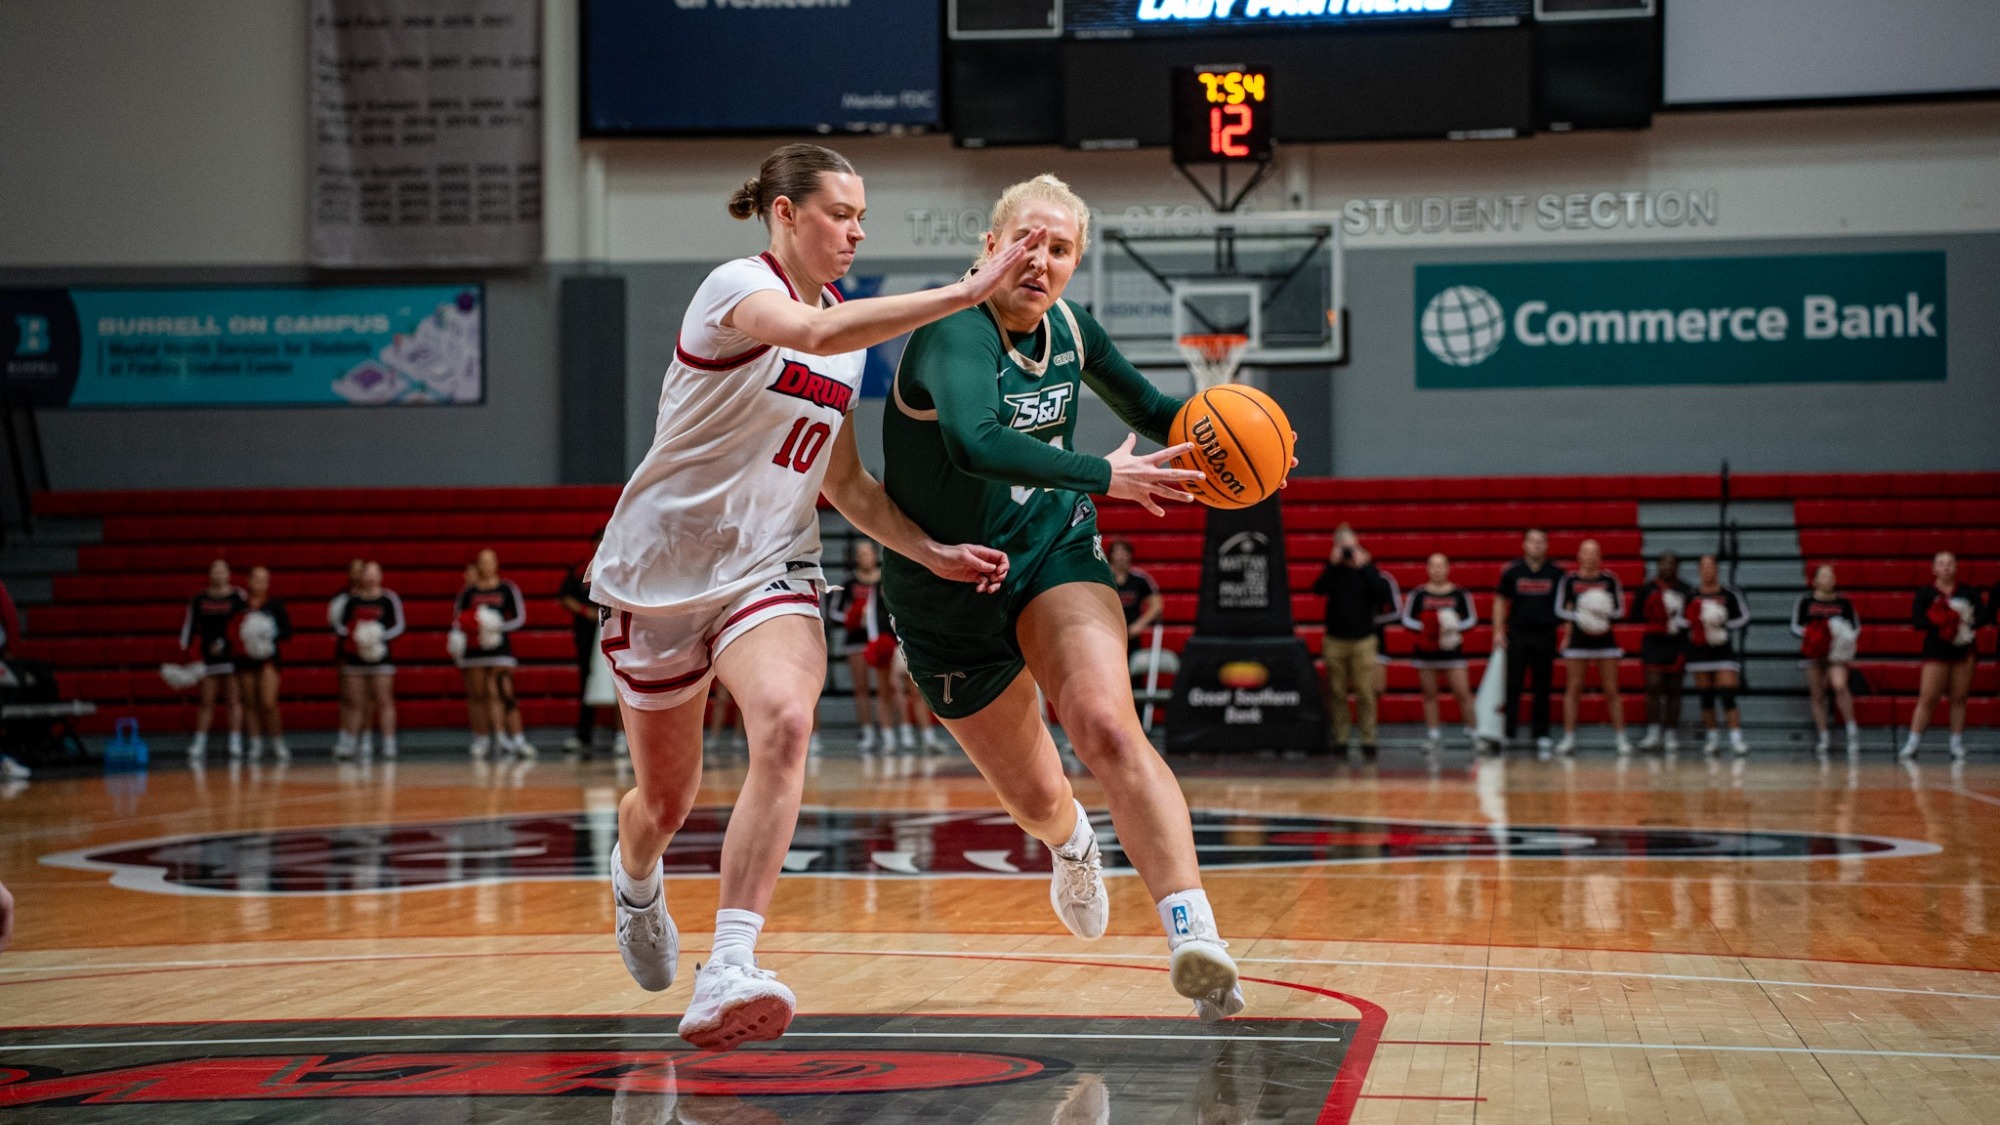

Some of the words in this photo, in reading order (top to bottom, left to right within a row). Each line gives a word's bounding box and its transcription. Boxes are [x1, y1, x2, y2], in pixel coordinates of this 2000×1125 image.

[1199, 72, 1265, 104] 7:54
[1211, 104, 1252, 156] 12
[1342, 197, 1527, 235] STUDENT
[1536, 190, 1717, 231] SECTION
[98, 316, 222, 336] BURRELL
[228, 315, 267, 335] ON
[274, 314, 390, 334] CAMPUS
[1513, 301, 1788, 346] Commerce
[1803, 292, 1938, 340] Bank
[770, 360, 853, 414] DRUR
[1010, 386, 1070, 429] S&T
[772, 417, 830, 473] 10
[1192, 415, 1246, 495] Wilson
[1224, 706, 1262, 724] Bank
